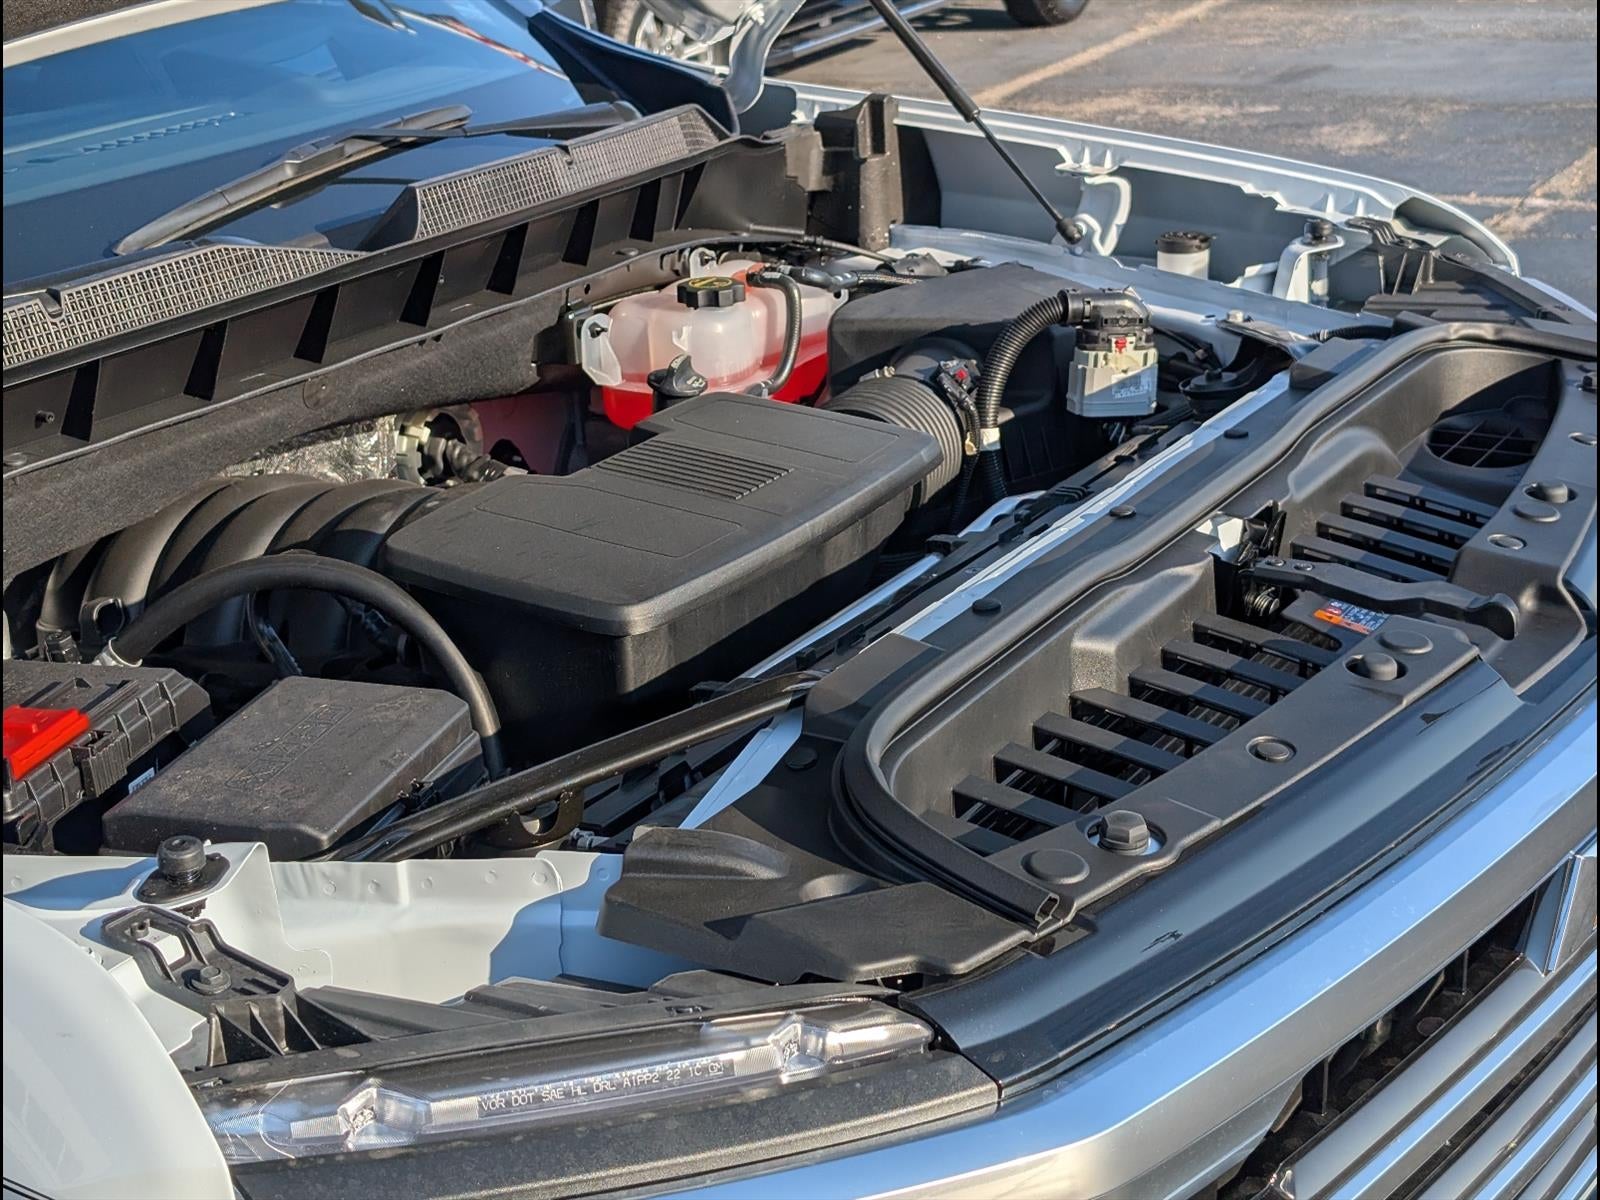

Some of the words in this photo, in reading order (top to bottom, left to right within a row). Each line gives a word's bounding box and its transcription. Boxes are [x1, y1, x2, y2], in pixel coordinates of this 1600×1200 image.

[511, 1092, 534, 1107] DOT
[541, 1087, 566, 1102] SAE
[571, 1085, 588, 1097] HL
[593, 1080, 617, 1094] DRL
[666, 1068, 681, 1081] 22
